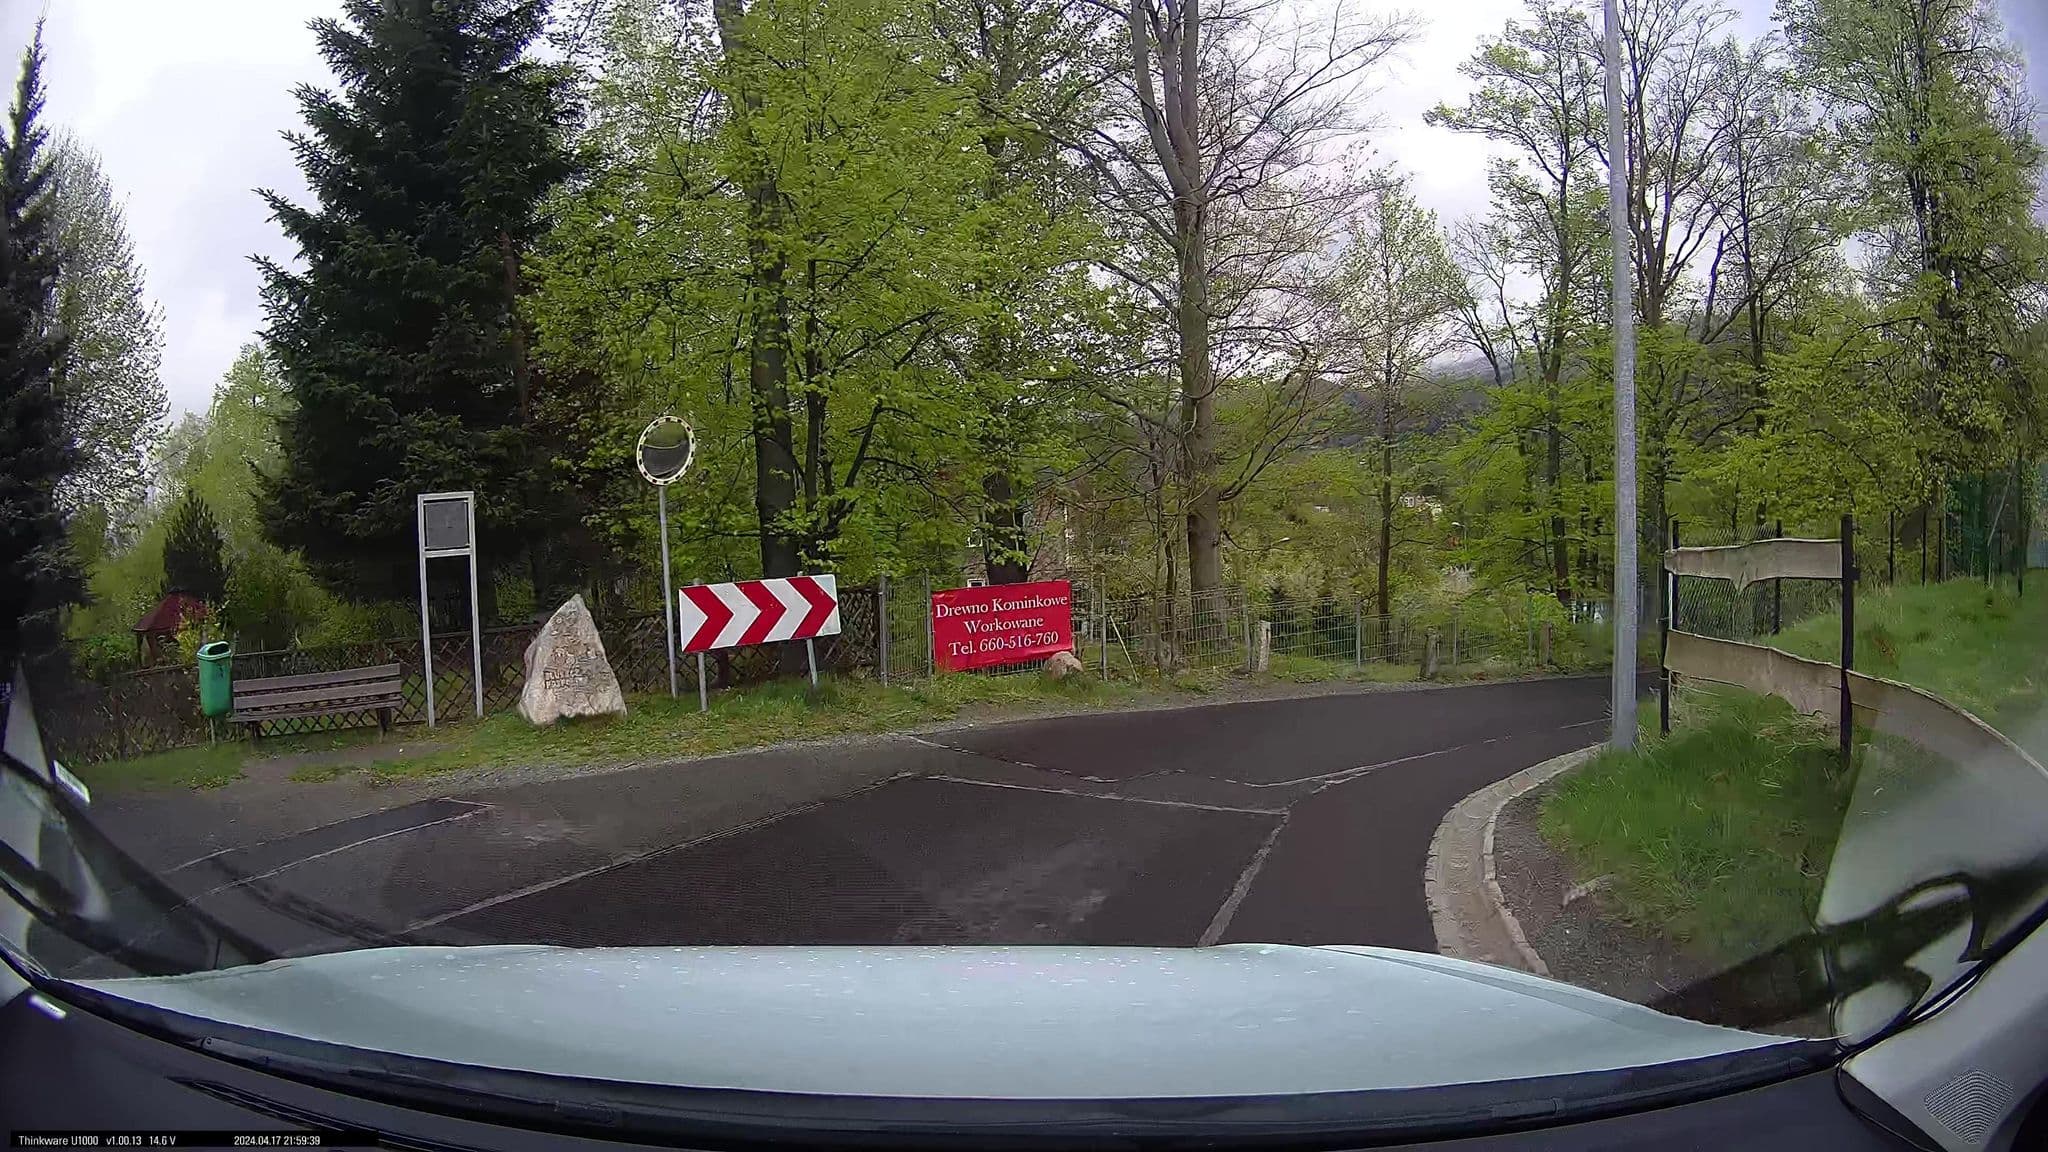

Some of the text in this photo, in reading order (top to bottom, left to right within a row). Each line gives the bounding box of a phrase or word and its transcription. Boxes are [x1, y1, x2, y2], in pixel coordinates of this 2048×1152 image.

[935, 595, 1068, 618] Drewno Kominkowe
[964, 617, 1044, 634] Workowane
[948, 631, 1059, 656] Tel. 660-516-760
